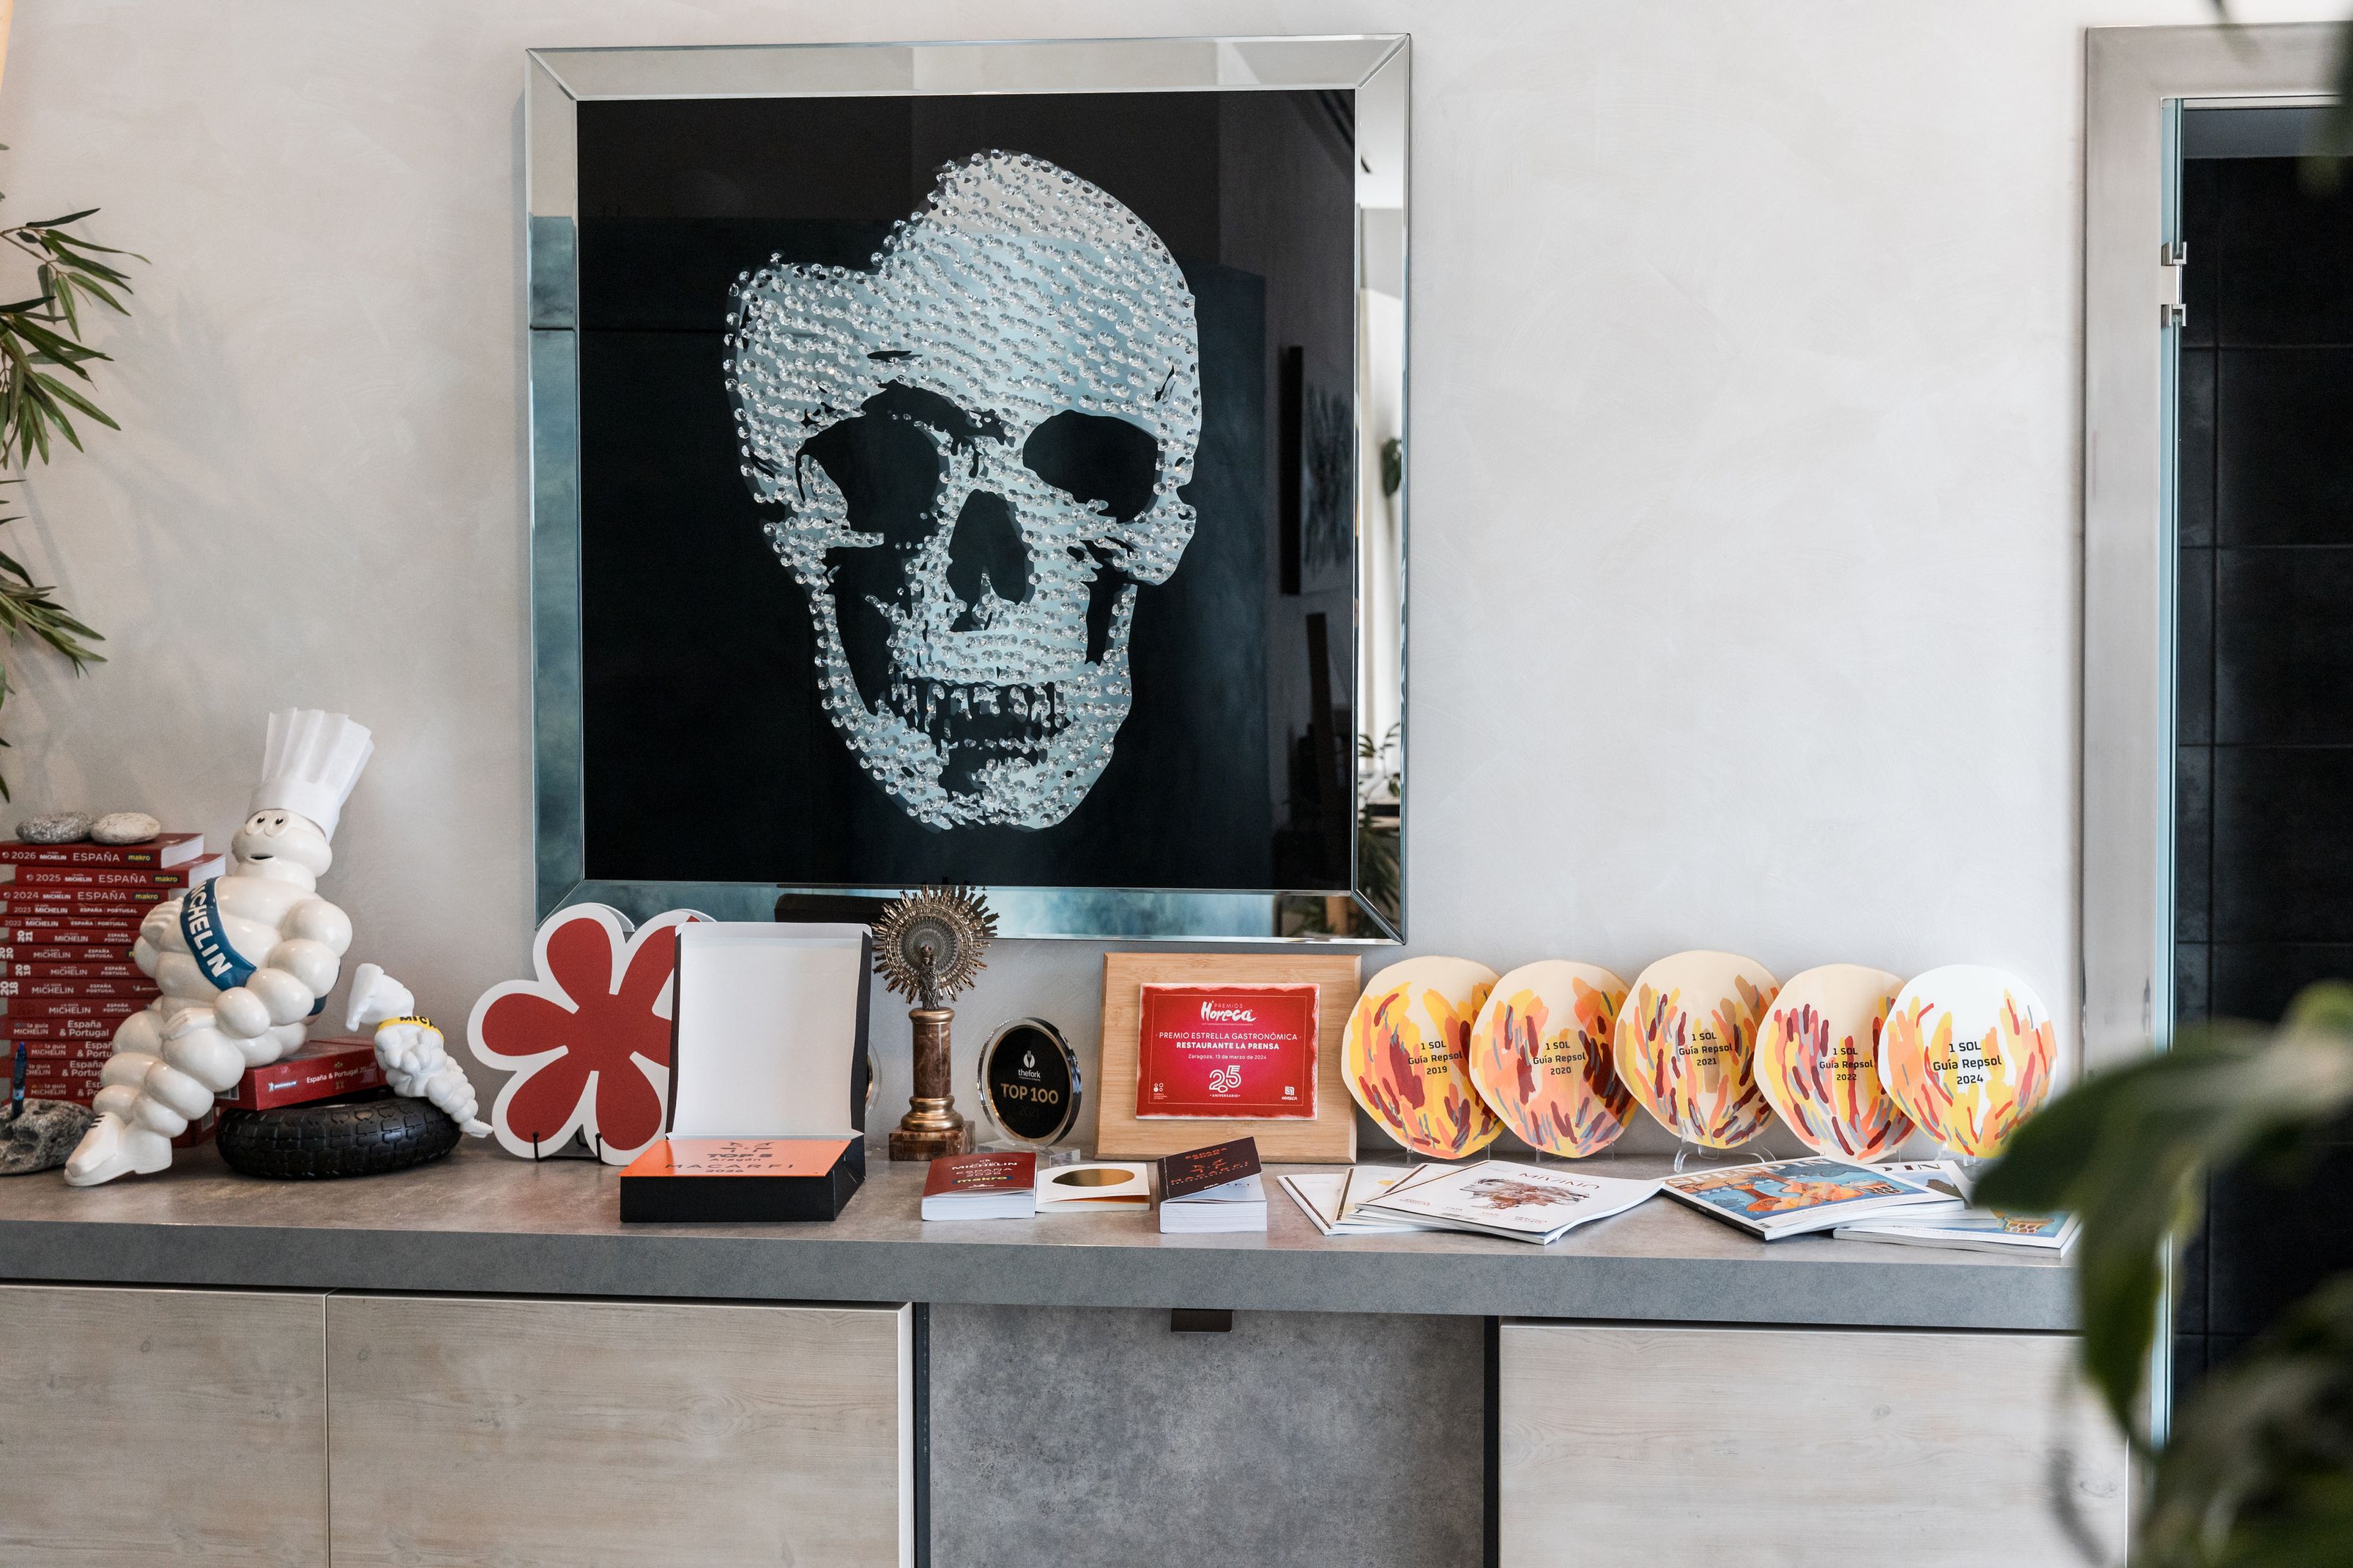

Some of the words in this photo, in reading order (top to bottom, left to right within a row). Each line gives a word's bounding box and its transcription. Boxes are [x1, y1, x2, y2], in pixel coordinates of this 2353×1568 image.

[12, 852, 37, 860] 2026
[73, 851, 120, 862] ESPAÑA
[36, 874, 62, 883] 2025
[99, 873, 146, 883] ESPAÑA
[13, 891, 40, 899] 2024
[78, 890, 127, 901] ESPAÑA
[31, 986, 74, 995] MICHELIN
[48, 1006, 91, 1014] MICHELIN
[1200, 1000, 1257, 1022] Horeca
[67, 1019, 101, 1029] España
[60, 1028, 67, 1036] &
[69, 1028, 109, 1038] Portugal
[1192, 1032, 1230, 1040] ESTRELLA
[1232, 1031, 1298, 1041] GASTRONÓMICA
[1699, 1032, 1717, 1040] SOL
[1176, 1041, 1234, 1049] RESTAURANTE
[1248, 1042, 1279, 1050] PRENSA
[1429, 1041, 1446, 1049] SOL
[1553, 1041, 1571, 1049] SOL
[1679, 1045, 1699, 1055] Guía
[1702, 1043, 1733, 1055] Repsol
[1949, 1043, 1955, 1053] 1
[1958, 1041, 1982, 1052] SOL
[77, 1049, 83, 1057] &
[86, 1049, 112, 1058] Portu
[1833, 1047, 1837, 1055] 1
[1840, 1047, 1859, 1055] SOL
[1408, 1055, 1428, 1065] Guía
[1431, 1050, 1463, 1063] Repsol
[1533, 1055, 1553, 1065] Guía
[1555, 1052, 1586, 1063] Repsol
[1697, 1058, 1717, 1066] 2021
[70, 1060, 103, 1070] España
[1819, 1060, 1839, 1069] Guía
[1842, 1059, 1873, 1070] Repsol
[1933, 1059, 1958, 1071] Guía
[1962, 1055, 2002, 1070] Repsol
[306, 1074, 327, 1084] España
[334, 1067, 359, 1080] Portugal
[1018, 1069, 1041, 1079] thefork
[1427, 1066, 1448, 1075] 2019
[1550, 1066, 1572, 1075] 2020
[1957, 1074, 1984, 1085] 2024
[86, 1080, 103, 1090] Esp
[77, 1089, 84, 1097] &
[1000, 1083, 1028, 1100] TOP
[1030, 1088, 1059, 1104] 100
[1668, 1162, 1787, 1187] SPEND
[1794, 1158, 1832, 1167] IN
